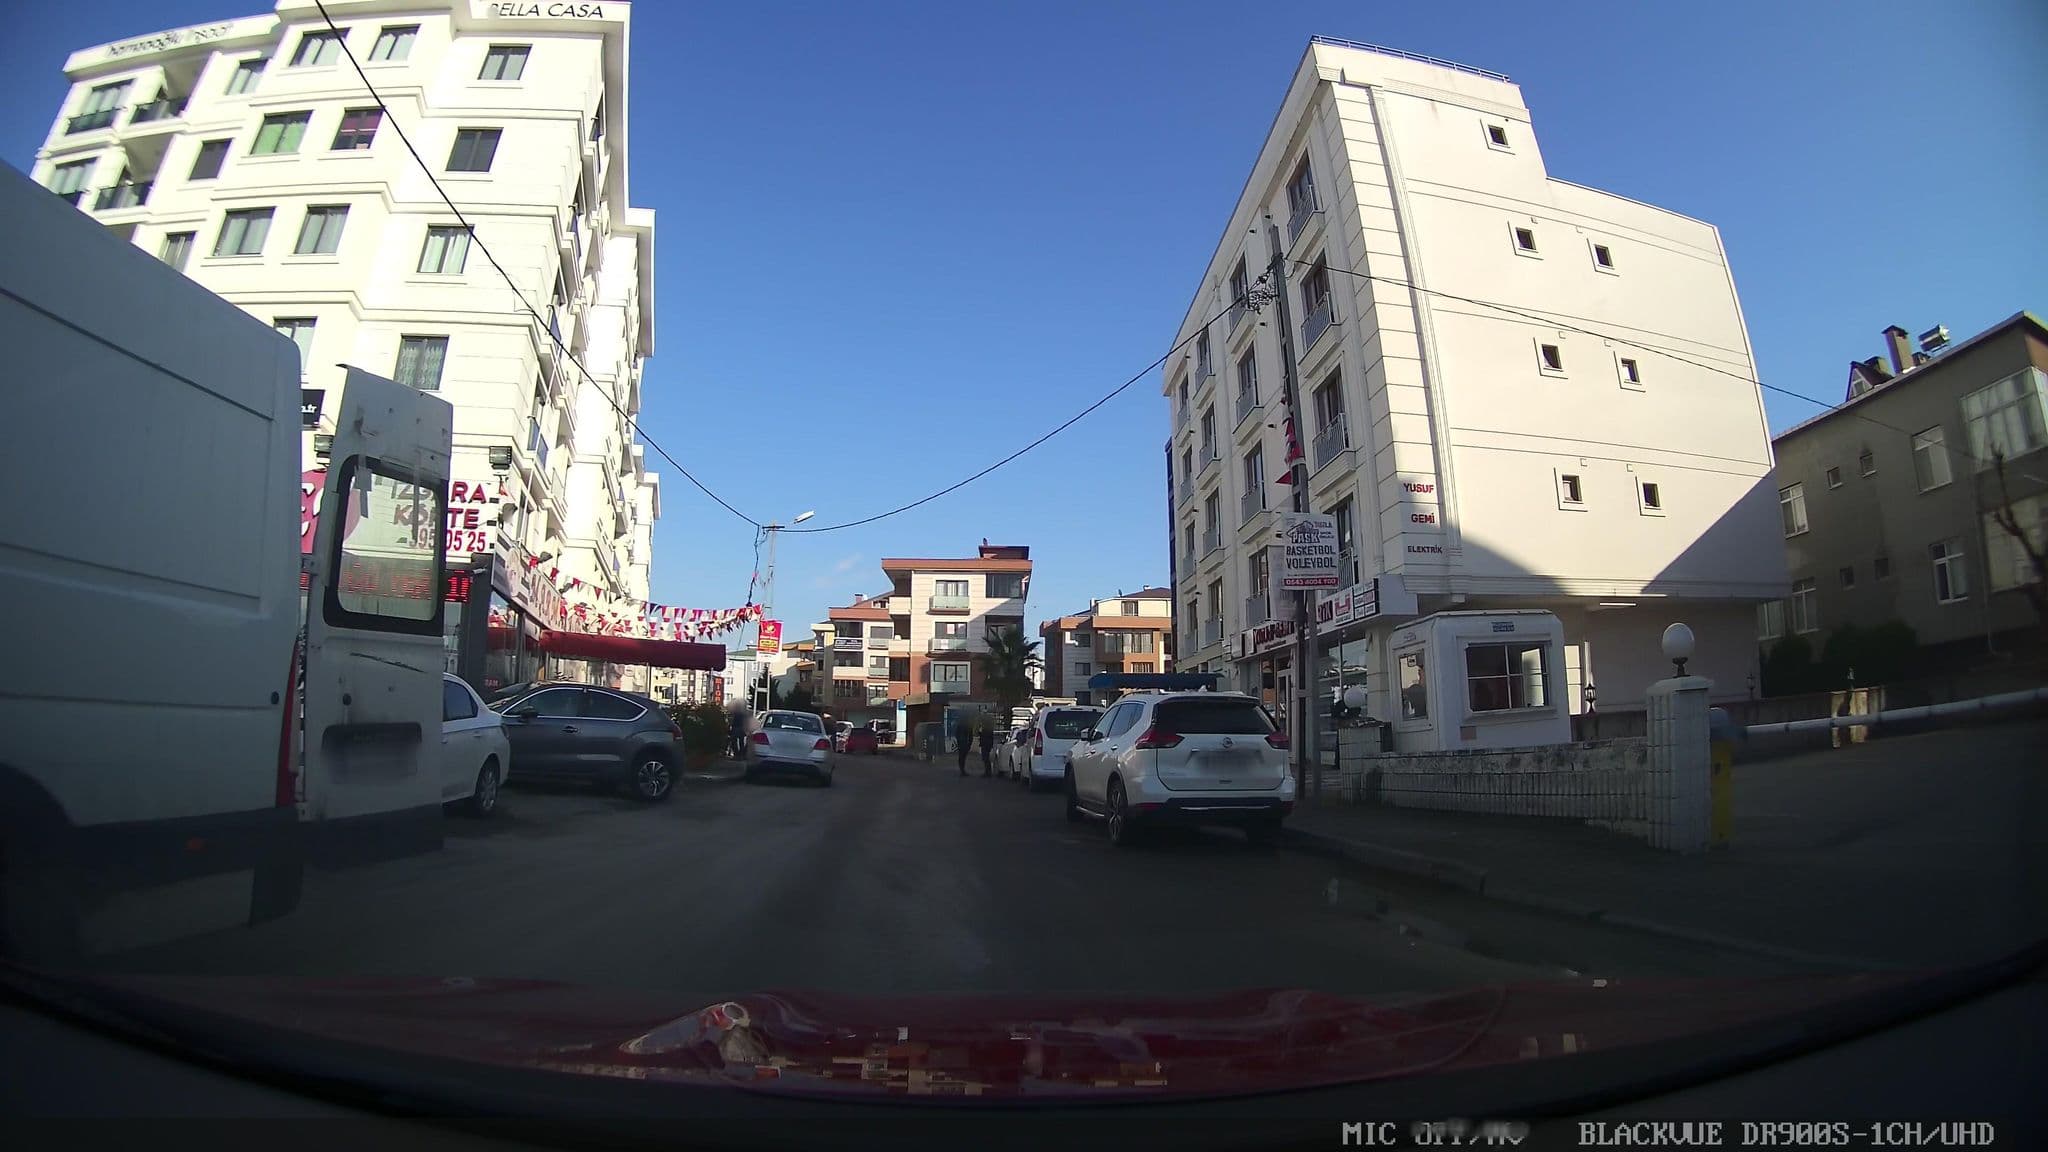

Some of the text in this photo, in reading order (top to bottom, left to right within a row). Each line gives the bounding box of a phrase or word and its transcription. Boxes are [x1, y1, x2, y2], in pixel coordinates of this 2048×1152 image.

[547, 4, 604, 18] CASA
[1403, 483, 1435, 494] YUSUF
[1411, 512, 1436, 524] GEMİ
[466, 531, 486, 552] 25
[1286, 545, 1337, 556] BASKETBOL
[1407, 544, 1443, 554] ELEKTRİK
[1286, 557, 1338, 569] VOLEYBOL
